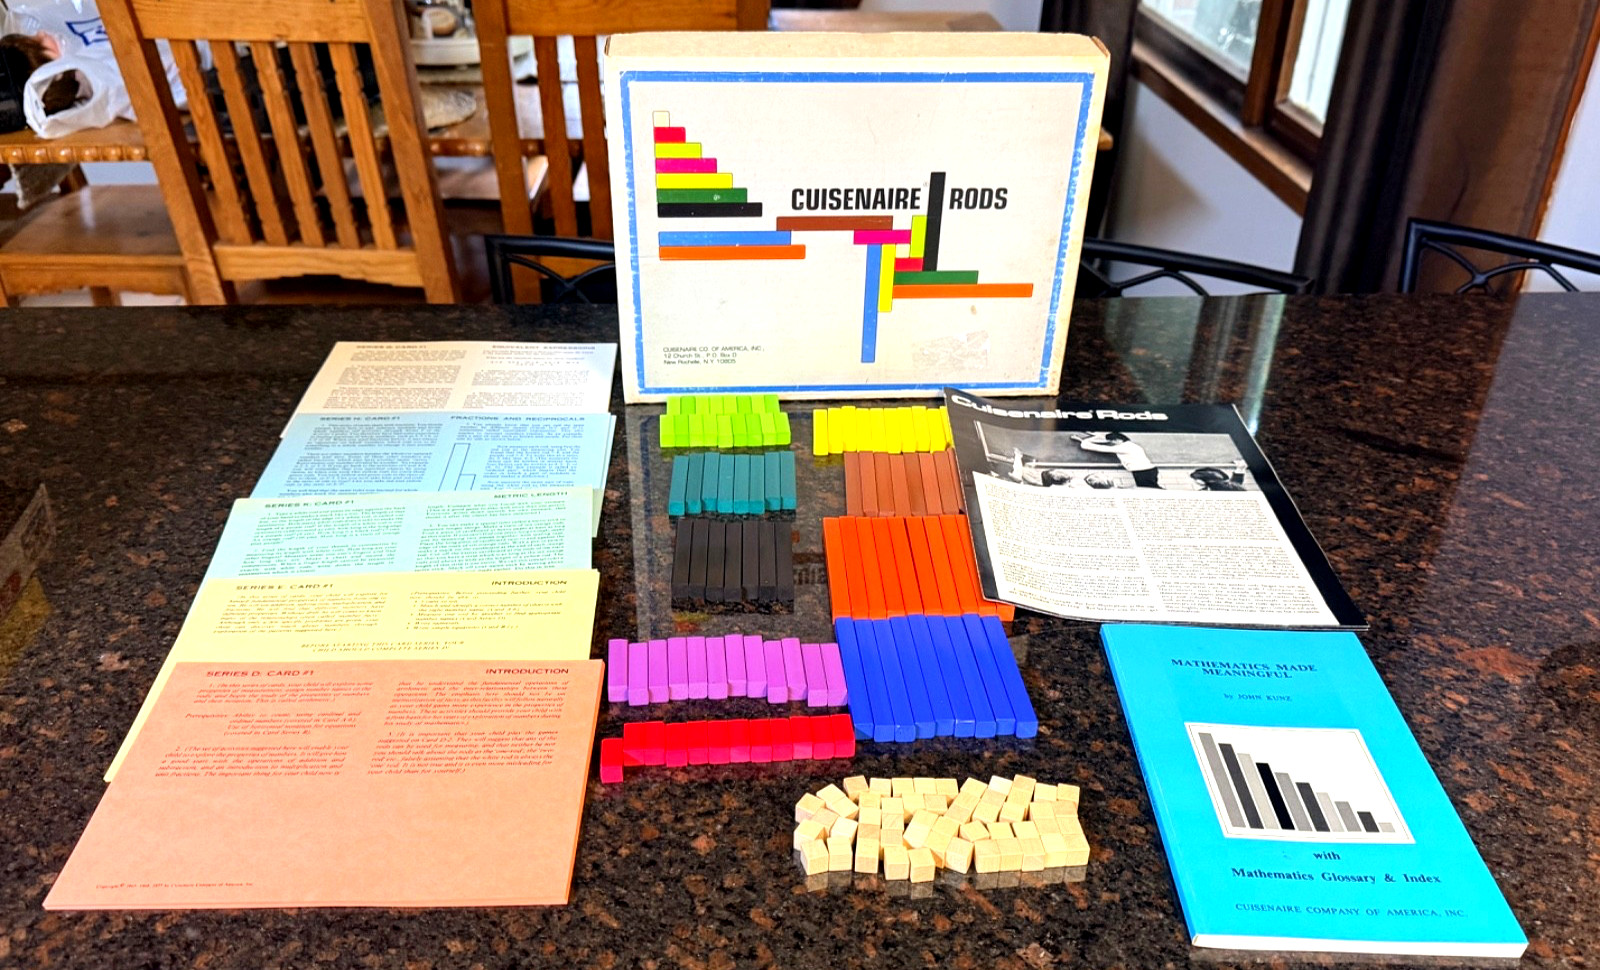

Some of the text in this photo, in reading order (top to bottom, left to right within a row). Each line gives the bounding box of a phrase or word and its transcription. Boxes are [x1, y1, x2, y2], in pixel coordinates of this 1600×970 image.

[791, 187, 1008, 210] CUISENAIRE RODS
[1096, 409, 1169, 421] Rods
[1171, 658, 1318, 672] MATHEMATICS MADE
[1202, 668, 1293, 679] MEANINGFUL
[1223, 693, 1234, 701] by
[1266, 694, 1293, 702] KUNZ
[1313, 851, 1341, 861] with
[1231, 867, 1442, 885] Mathematics Glossary & Index
[1235, 902, 1301, 913] CUISENAIRE
[1306, 906, 1360, 916] COMPANY
[1366, 908, 1381, 916] OF
